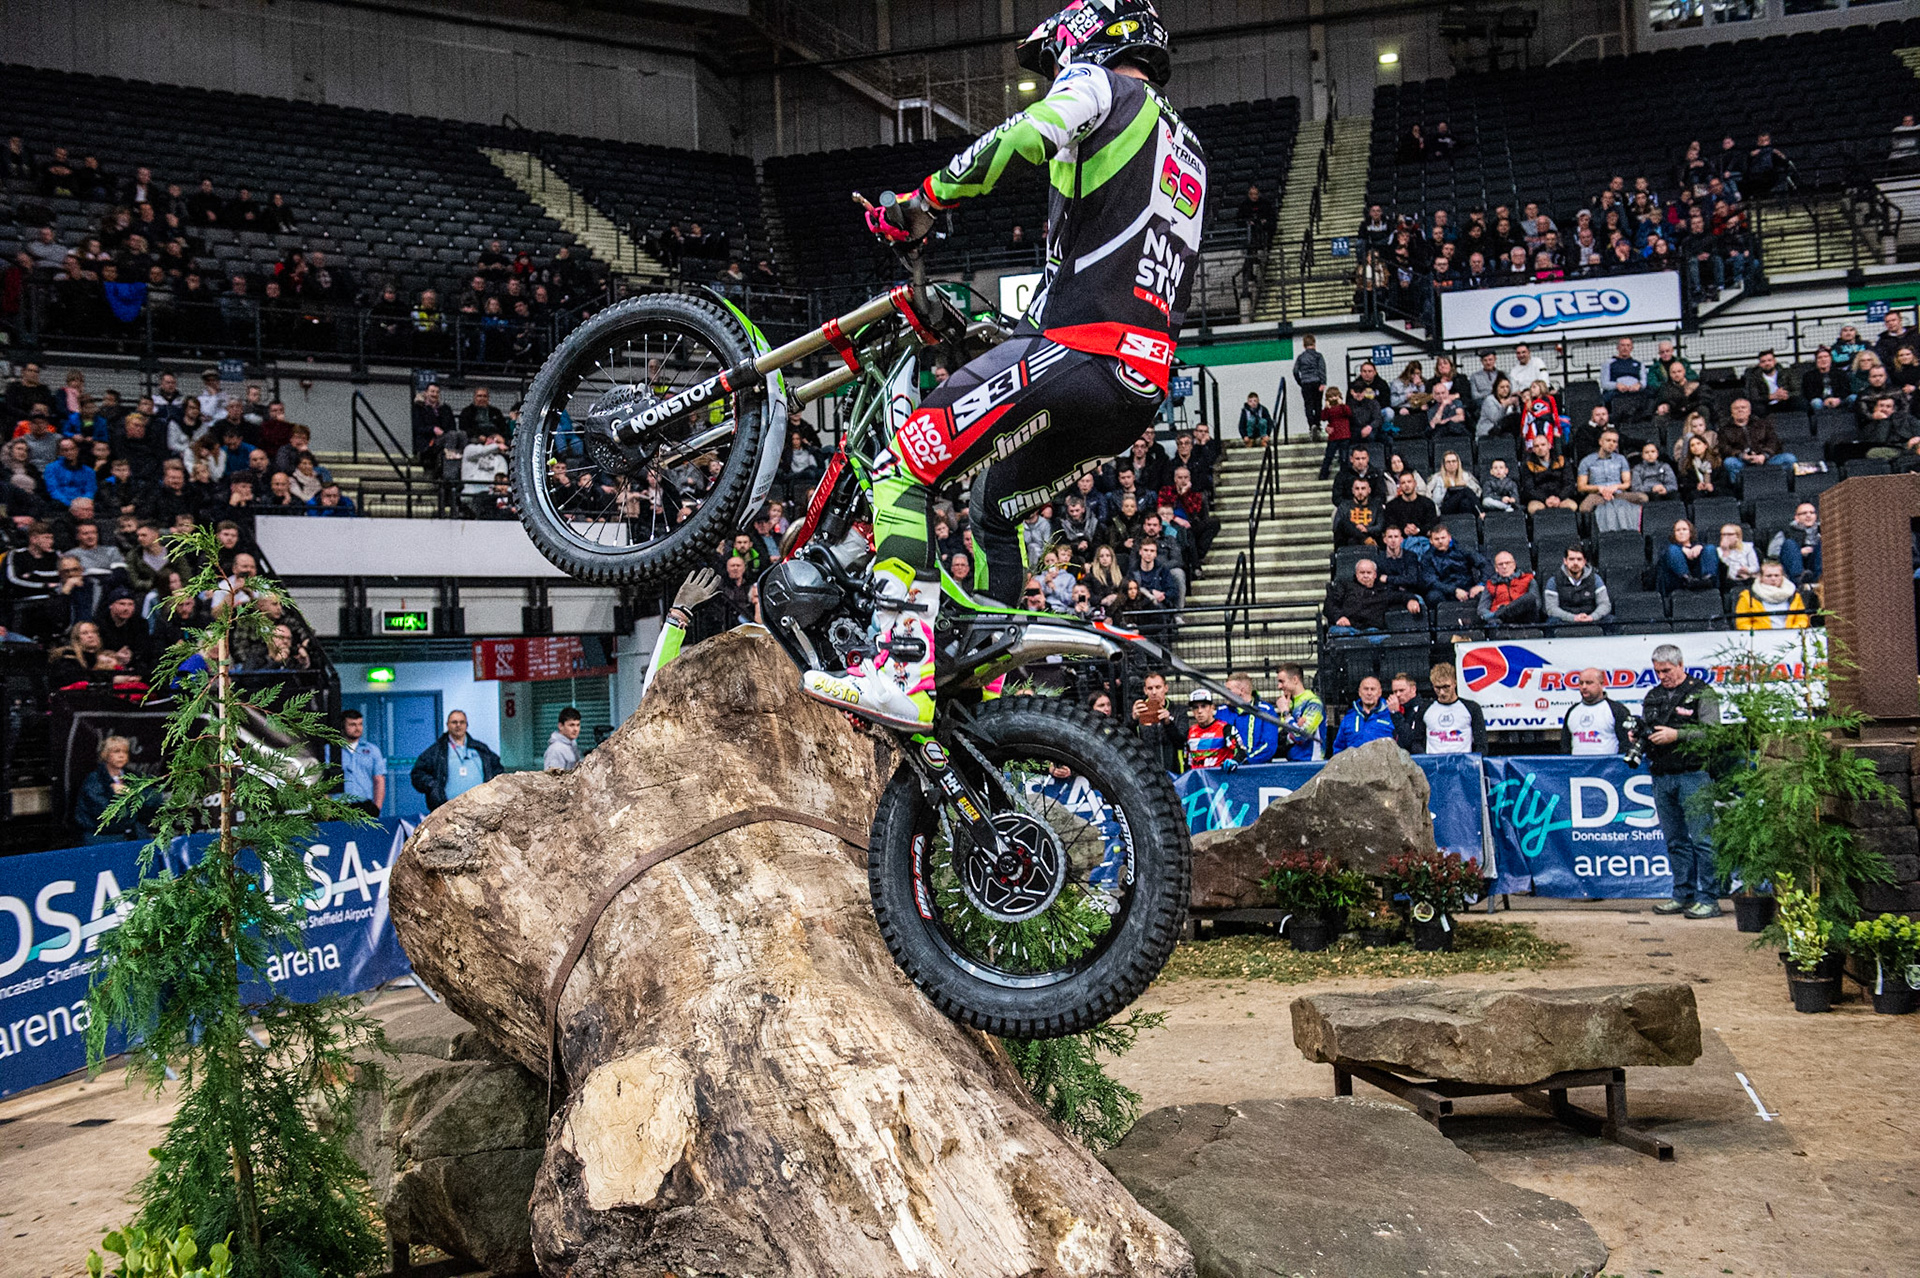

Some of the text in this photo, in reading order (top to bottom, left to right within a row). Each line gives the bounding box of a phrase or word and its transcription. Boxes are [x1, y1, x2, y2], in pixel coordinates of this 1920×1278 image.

[1067, 6, 1095, 32] NON
[1073, 14, 1099, 40] STOP
[1160, 153, 1202, 220] 69
[1493, 289, 1629, 331] OREO
[1174, 381, 1191, 390] 112
[630, 377, 717, 434] NONSTOP
[905, 421, 937, 466] STOP
[917, 413, 952, 462] NON
[814, 676, 860, 704] BUSTO
[505, 699, 516, 718] 8
[1489, 773, 1660, 858] Fly DS
[1572, 829, 1664, 842] Doncaster Sheffi
[1574, 854, 1672, 877] arena
[309, 910, 344, 929] Sheffield
[345, 906, 375, 923] Airport
[266, 943, 341, 983] arena
[0, 975, 46, 1000] ncaster
